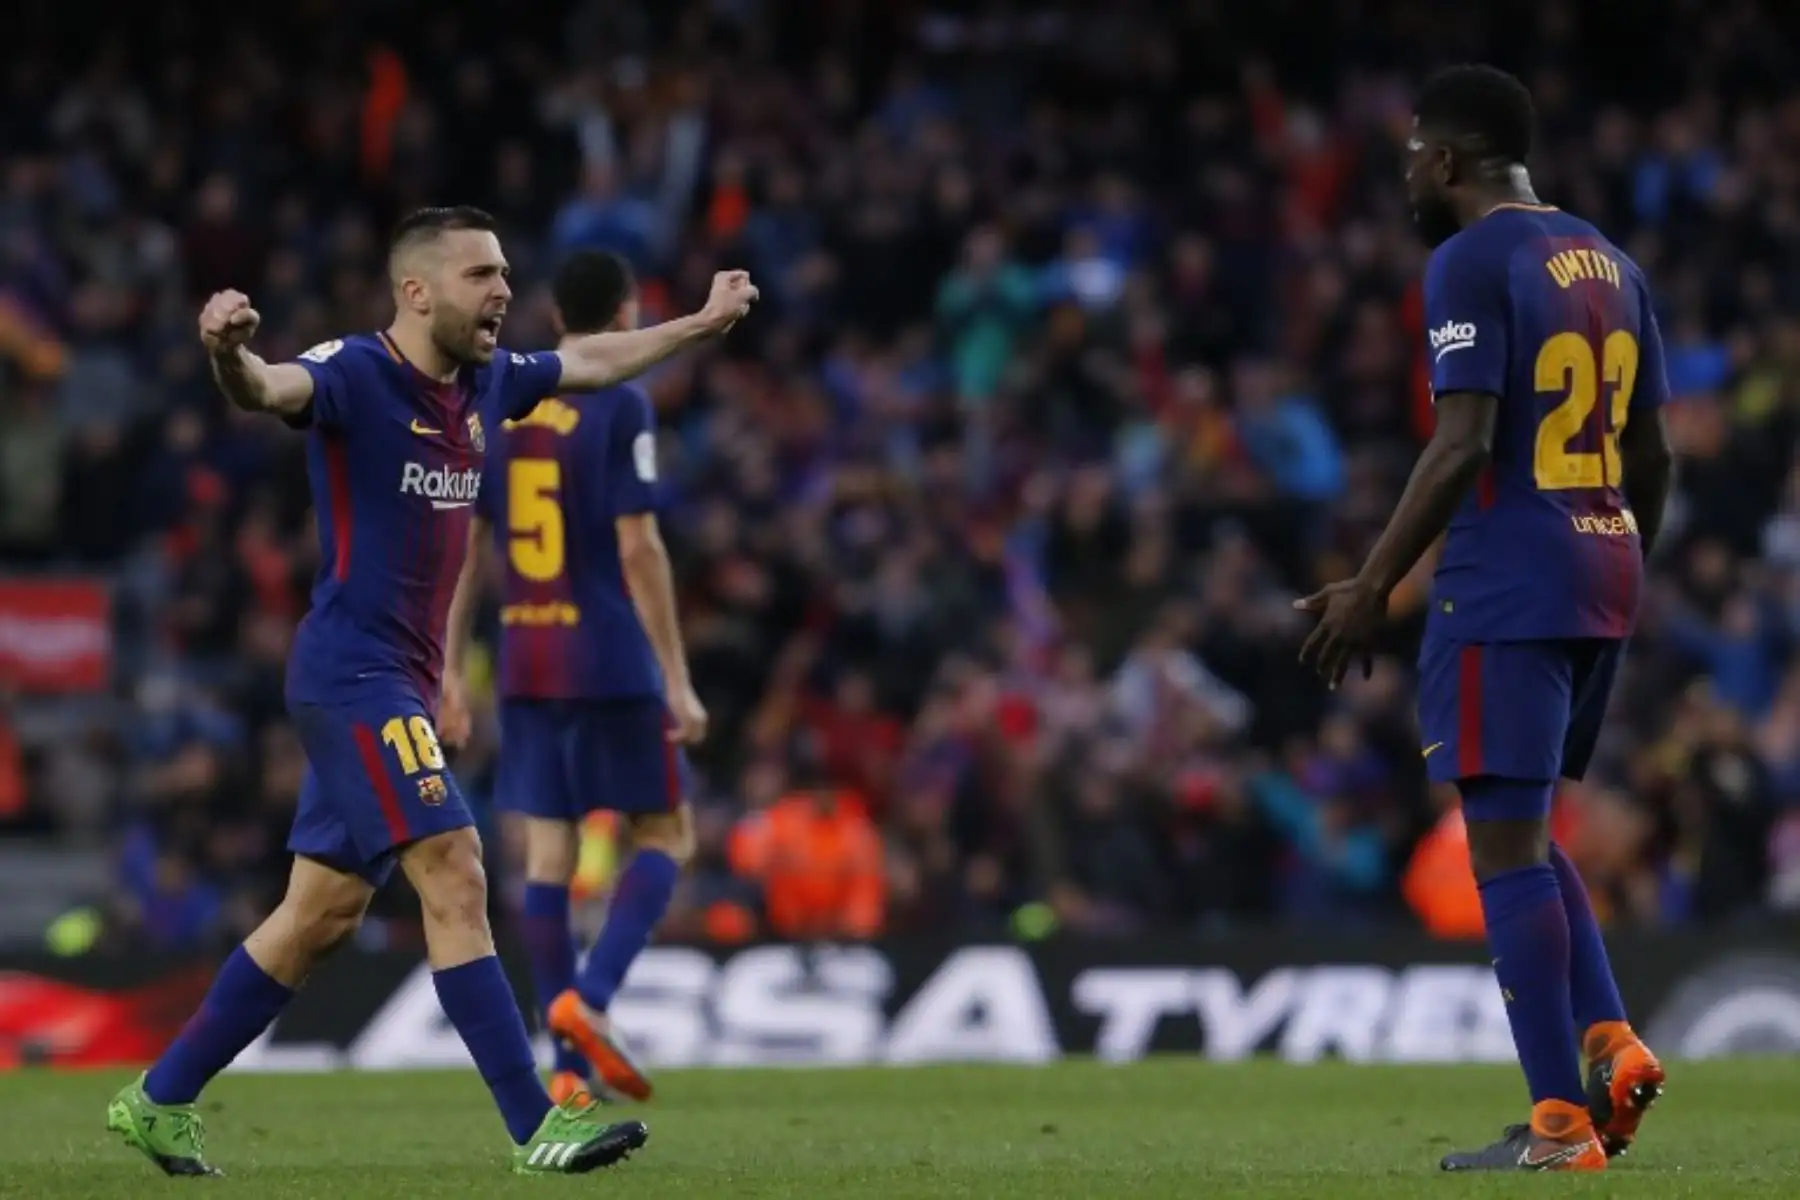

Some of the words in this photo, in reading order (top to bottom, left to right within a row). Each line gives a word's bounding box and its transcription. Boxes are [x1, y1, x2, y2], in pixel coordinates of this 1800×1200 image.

[1545, 249, 1620, 289] UMTITI
[1534, 329, 1639, 491] 23
[507, 458, 566, 582] 5
[381, 715, 445, 775] 18
